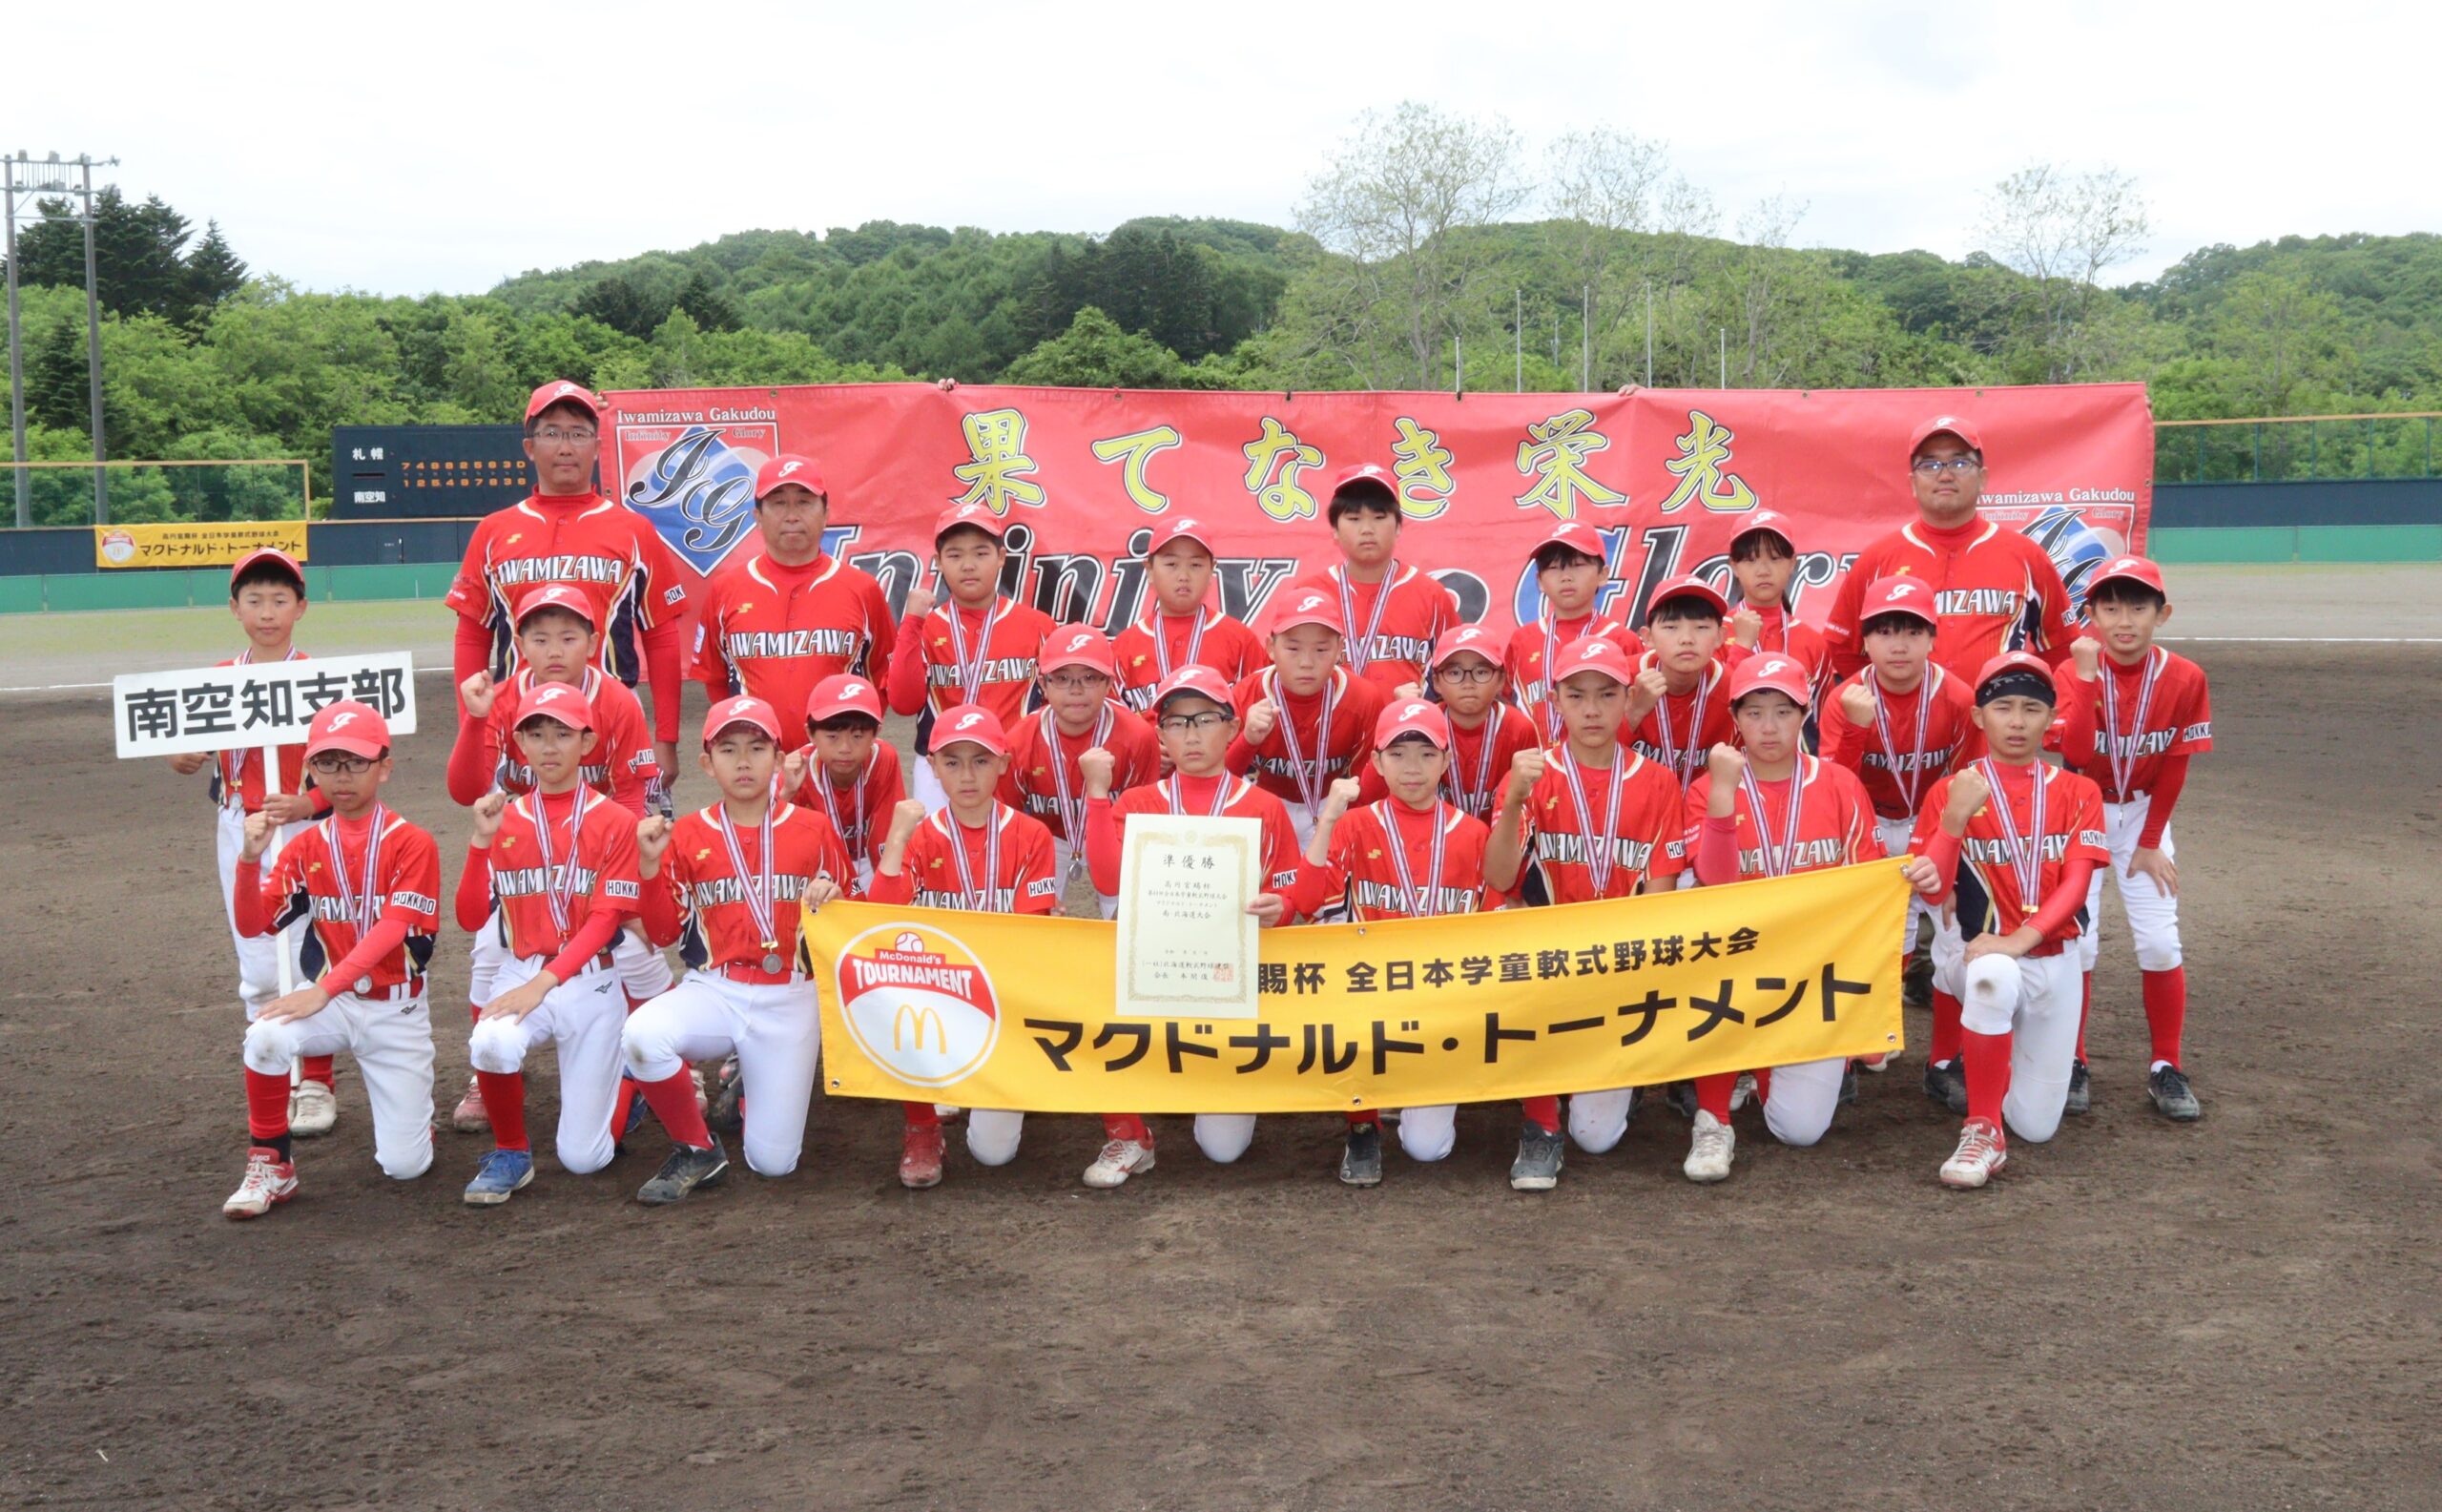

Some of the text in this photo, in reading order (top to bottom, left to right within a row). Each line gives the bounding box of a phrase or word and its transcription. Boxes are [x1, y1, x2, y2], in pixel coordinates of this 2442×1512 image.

[617, 407, 776, 424] Iwamizawa Gakudou
[354, 491, 385, 504] 南空知
[2069, 487, 2135, 502] Gakudou
[498, 555, 623, 586] IWAMIZAWA
[730, 629, 857, 658] IWAMIZAWA
[125, 667, 406, 742] 南空知支部
[880, 950, 942, 964] McDonald's
[1346, 926, 1761, 994] 全日本学童軟式野球大会
[853, 958, 973, 1001] TOURNAMENT
[1023, 962, 1873, 1076] マクドナルド・トーナメント
